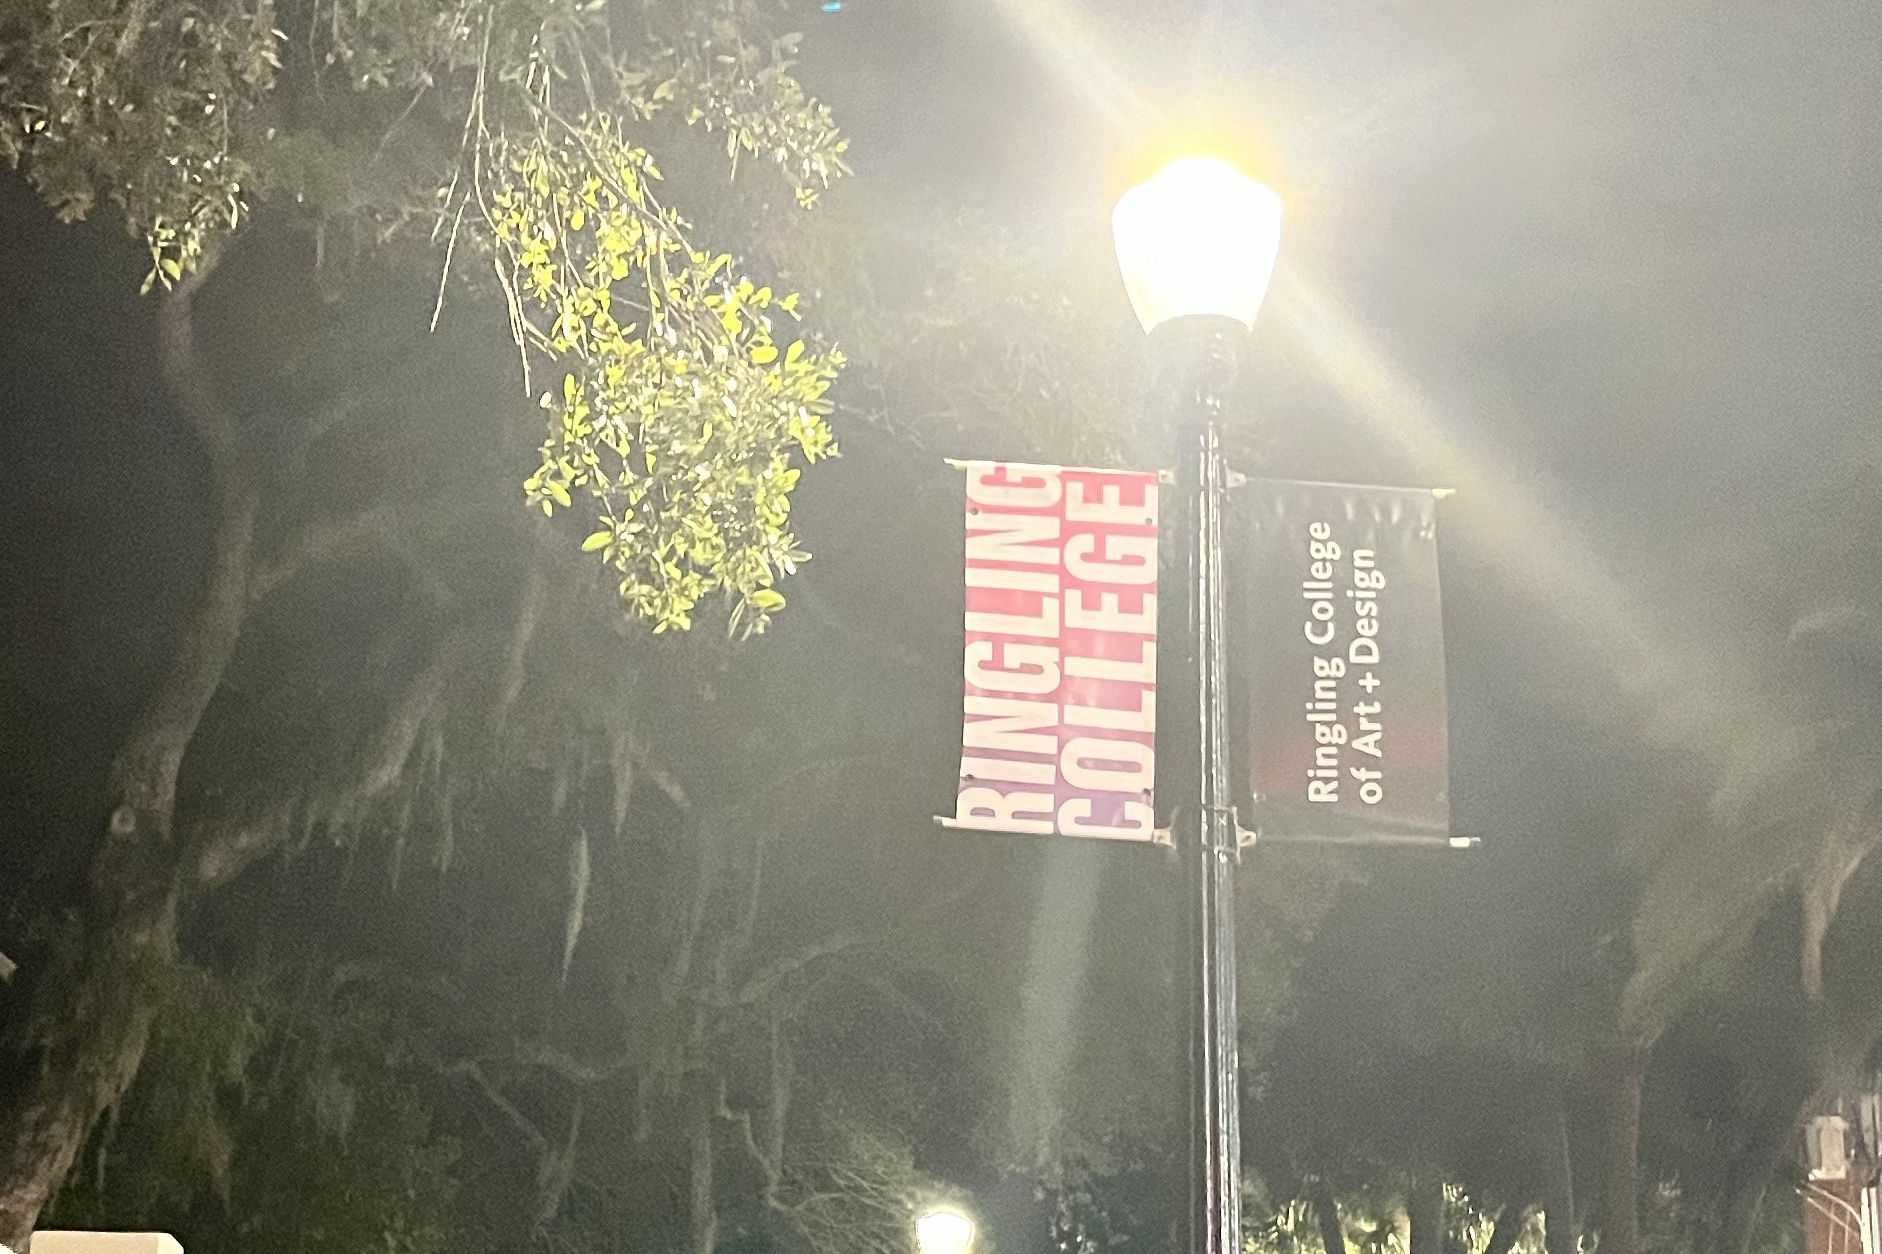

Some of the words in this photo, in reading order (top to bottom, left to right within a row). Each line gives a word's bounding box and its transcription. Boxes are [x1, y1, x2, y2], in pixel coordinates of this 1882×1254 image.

[1303, 521, 1341, 645] College
[1346, 549, 1386, 664] Design
[956, 464, 1062, 834] RINGLING
[1057, 481, 1158, 840] COLLEGE
[1358, 671, 1380, 693] +
[1307, 656, 1347, 802] Ringling
[1349, 767, 1382, 804] of
[1351, 701, 1382, 757] Art
